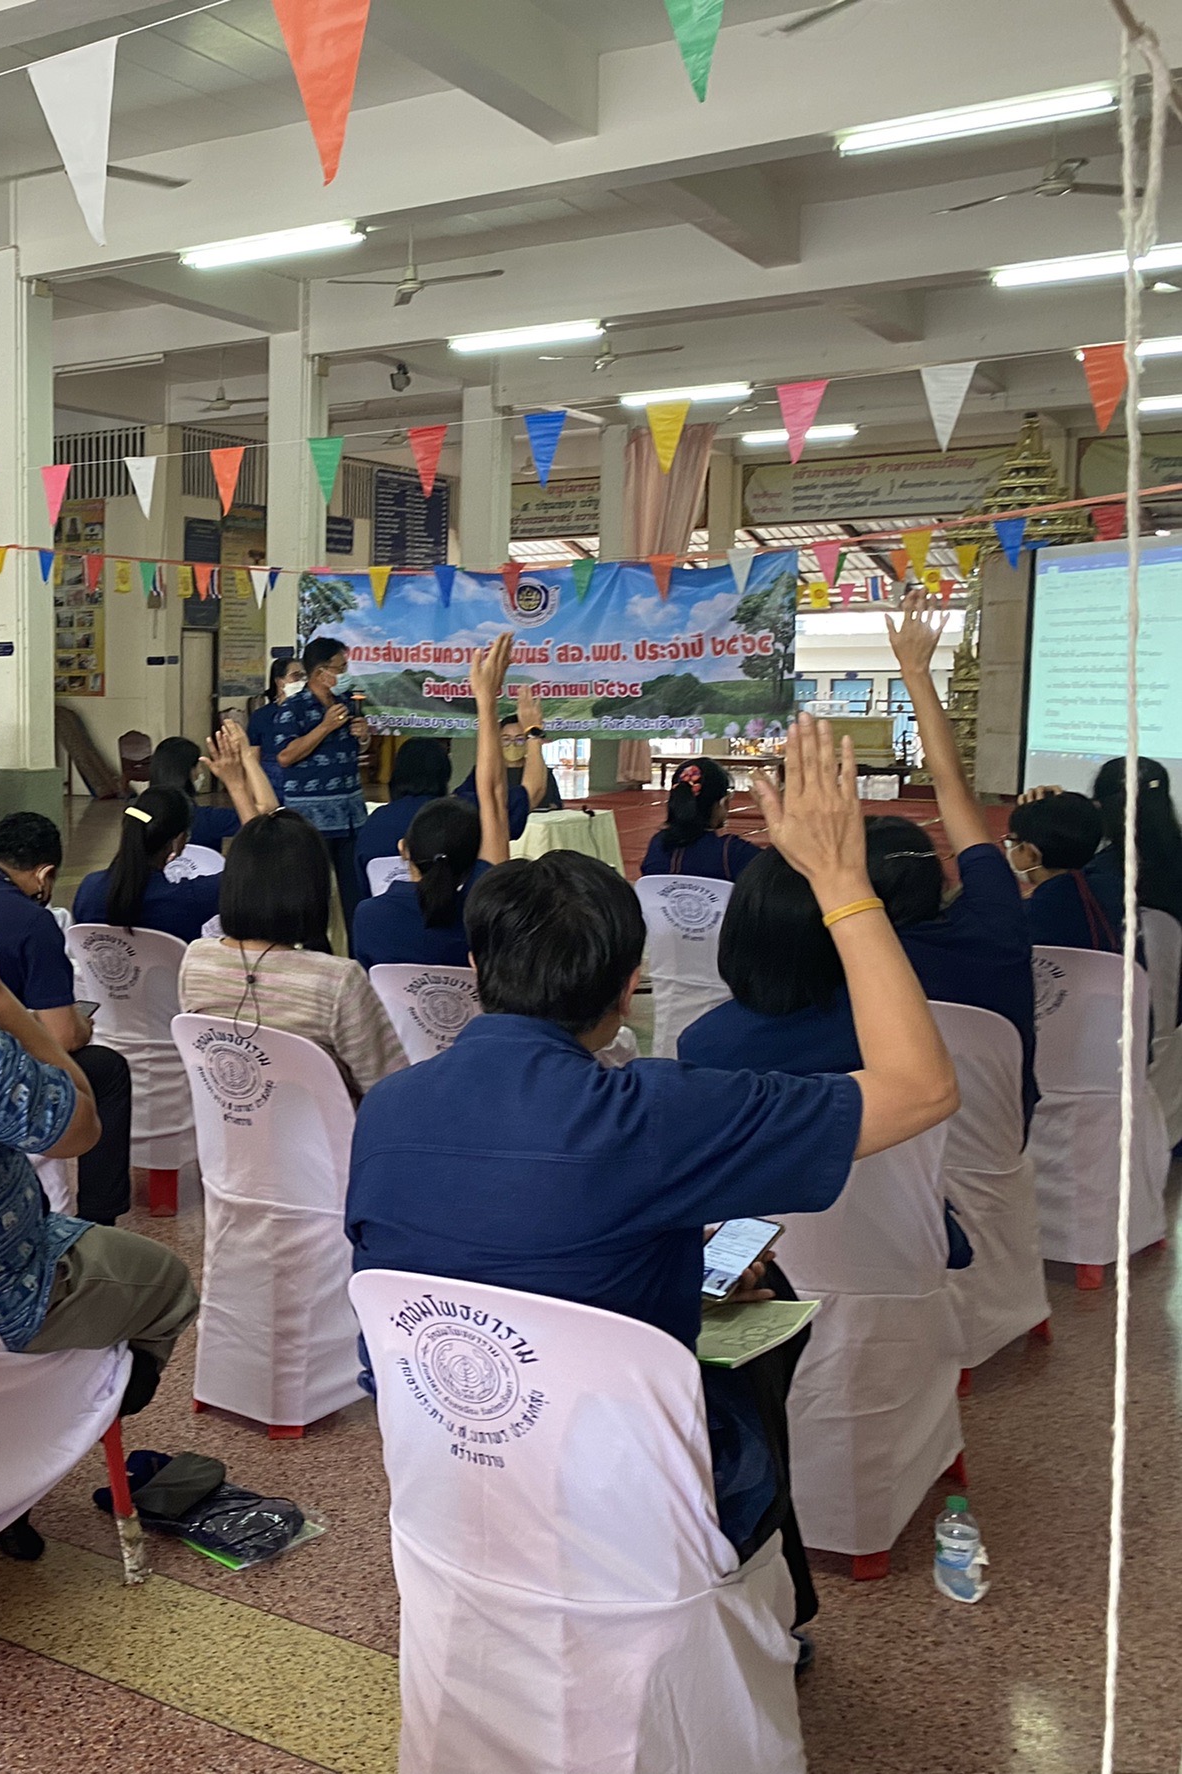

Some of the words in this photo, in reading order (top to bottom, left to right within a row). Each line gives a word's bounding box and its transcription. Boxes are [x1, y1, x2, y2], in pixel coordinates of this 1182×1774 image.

[634, 633, 704, 661] ประจำปี
[711, 633, 774, 656] ๒๕๖๔
[423, 678, 474, 700] วันศุกร์
[507, 680, 589, 697] พศจิกายน
[593, 682, 641, 697] ๒๕๖๔
